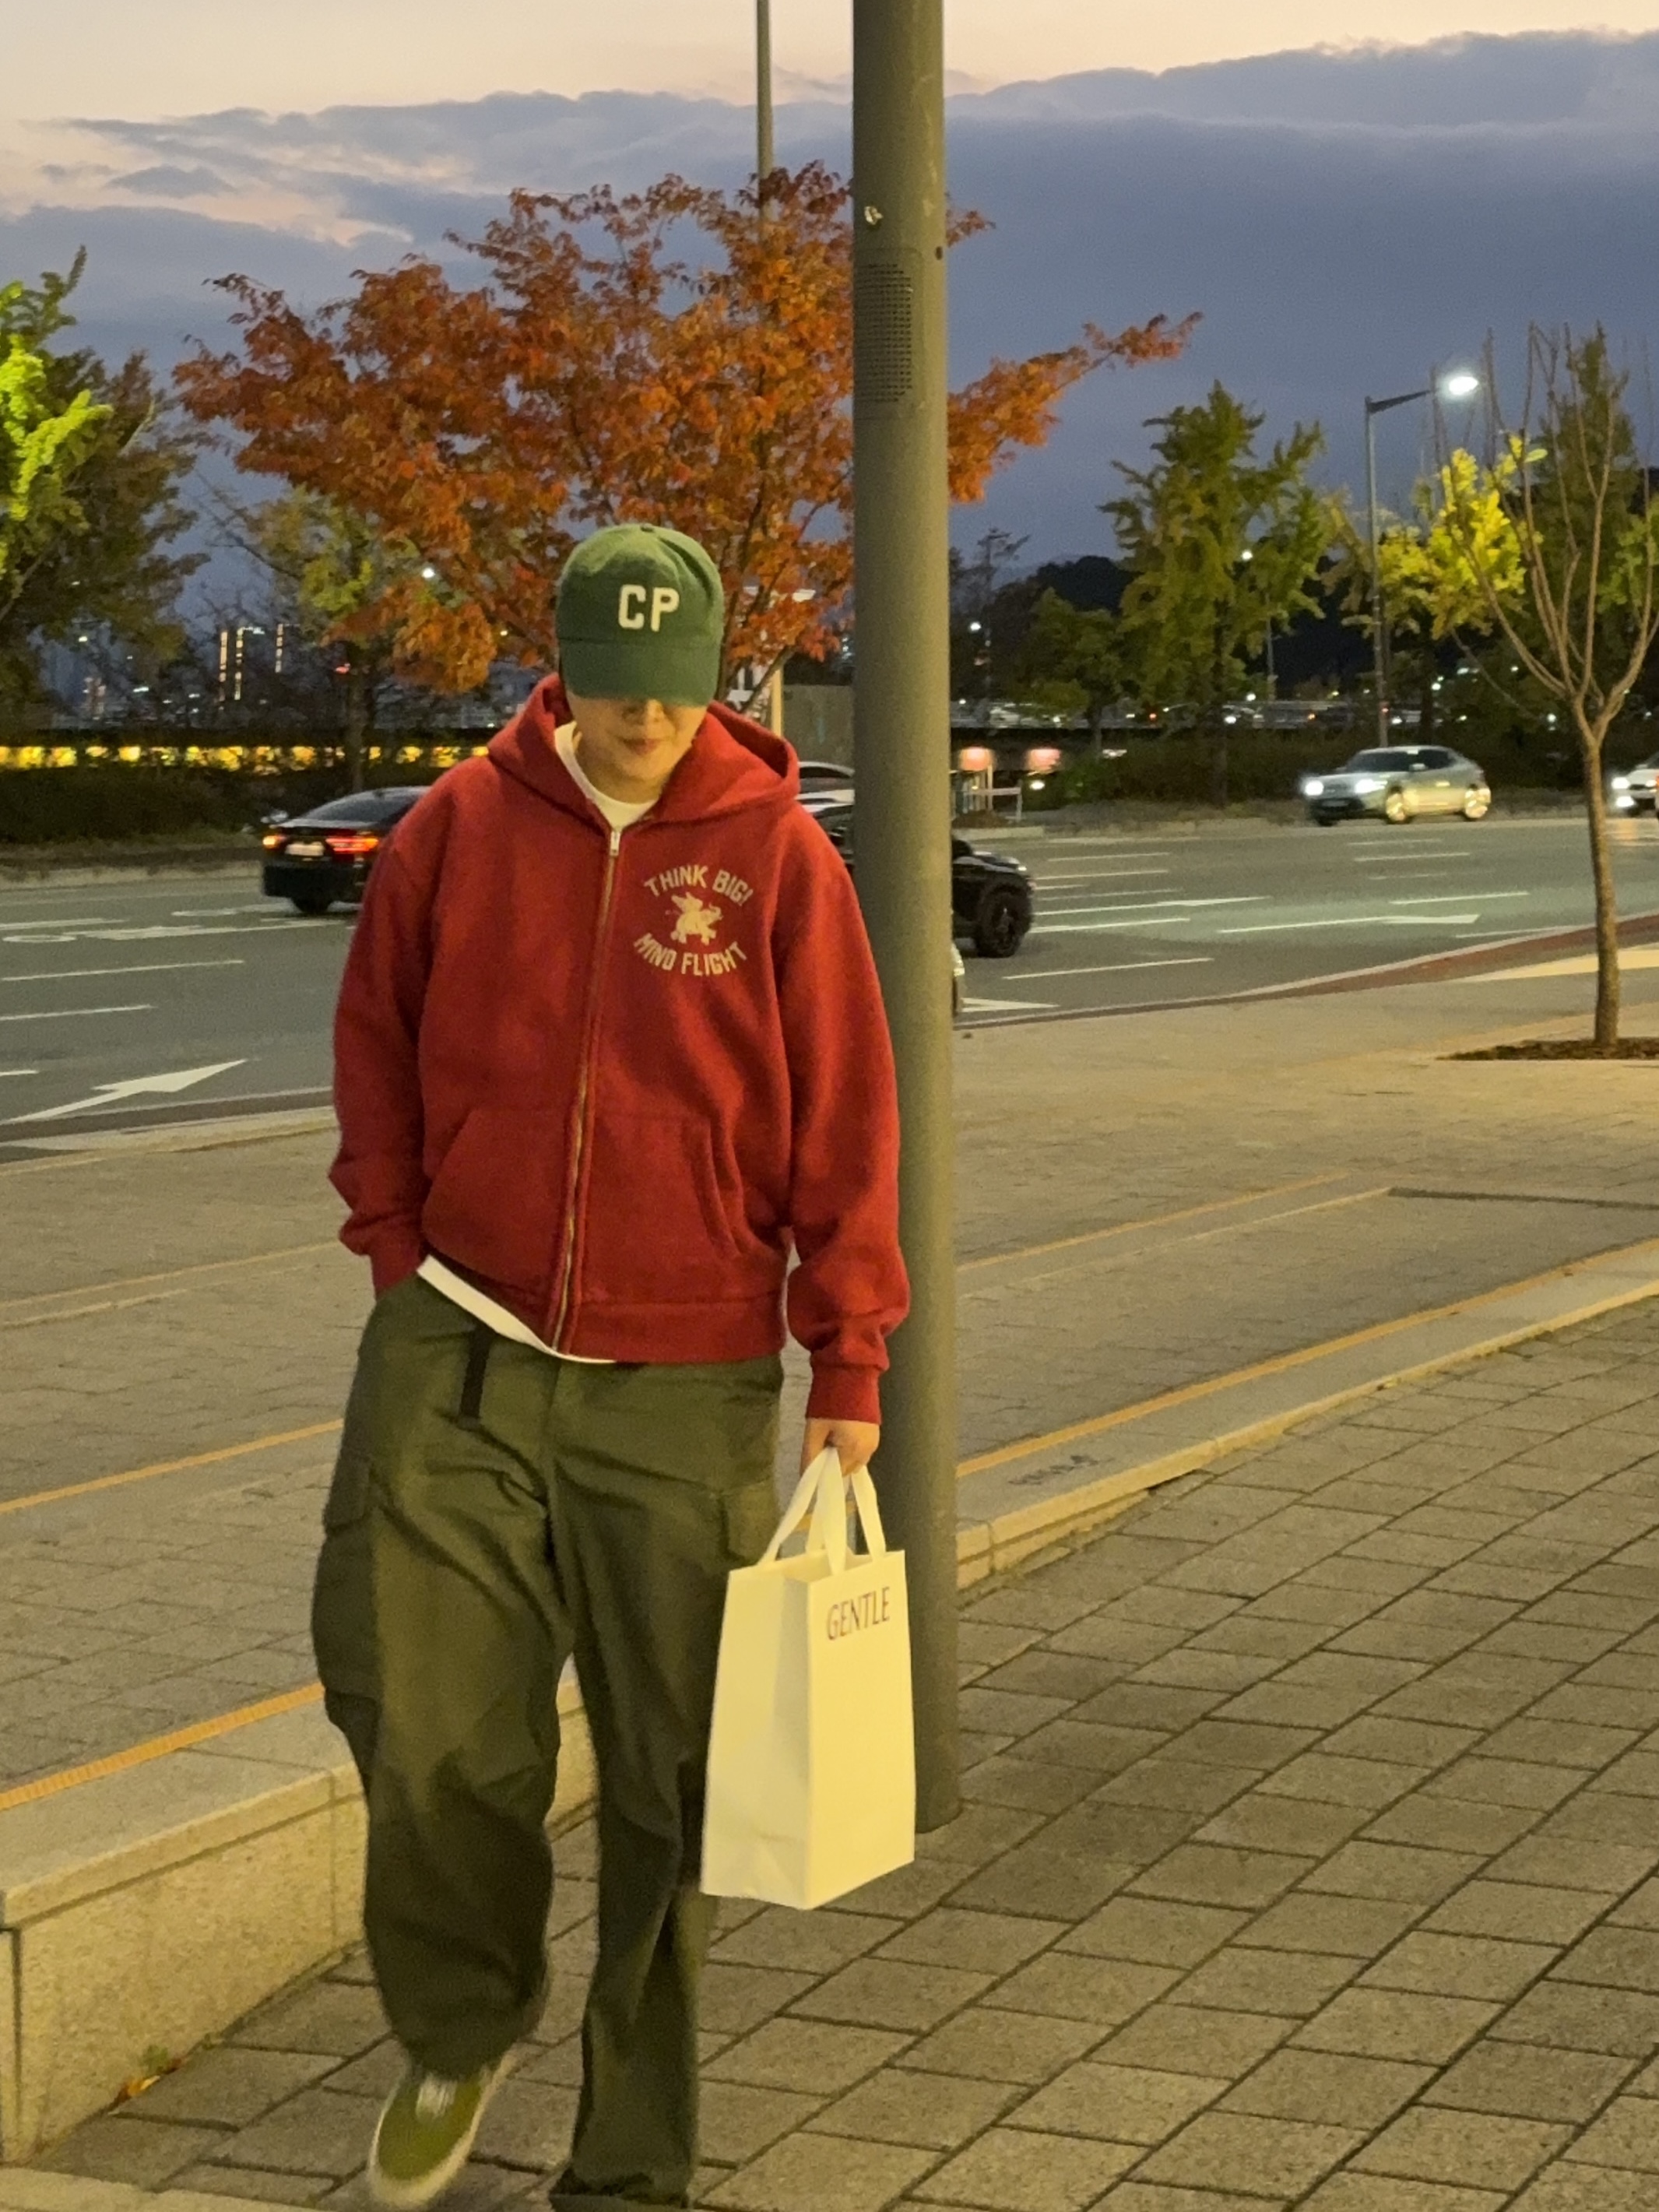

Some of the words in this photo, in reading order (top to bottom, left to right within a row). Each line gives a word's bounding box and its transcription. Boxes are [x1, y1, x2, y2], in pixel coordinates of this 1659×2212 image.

[618, 584, 680, 632] CP
[644, 864, 708, 896] THINK
[712, 870, 753, 906] BIG!
[634, 933, 677, 970] MIND
[681, 941, 747, 976] FLIGHT
[827, 1587, 890, 1641] GENTLE
